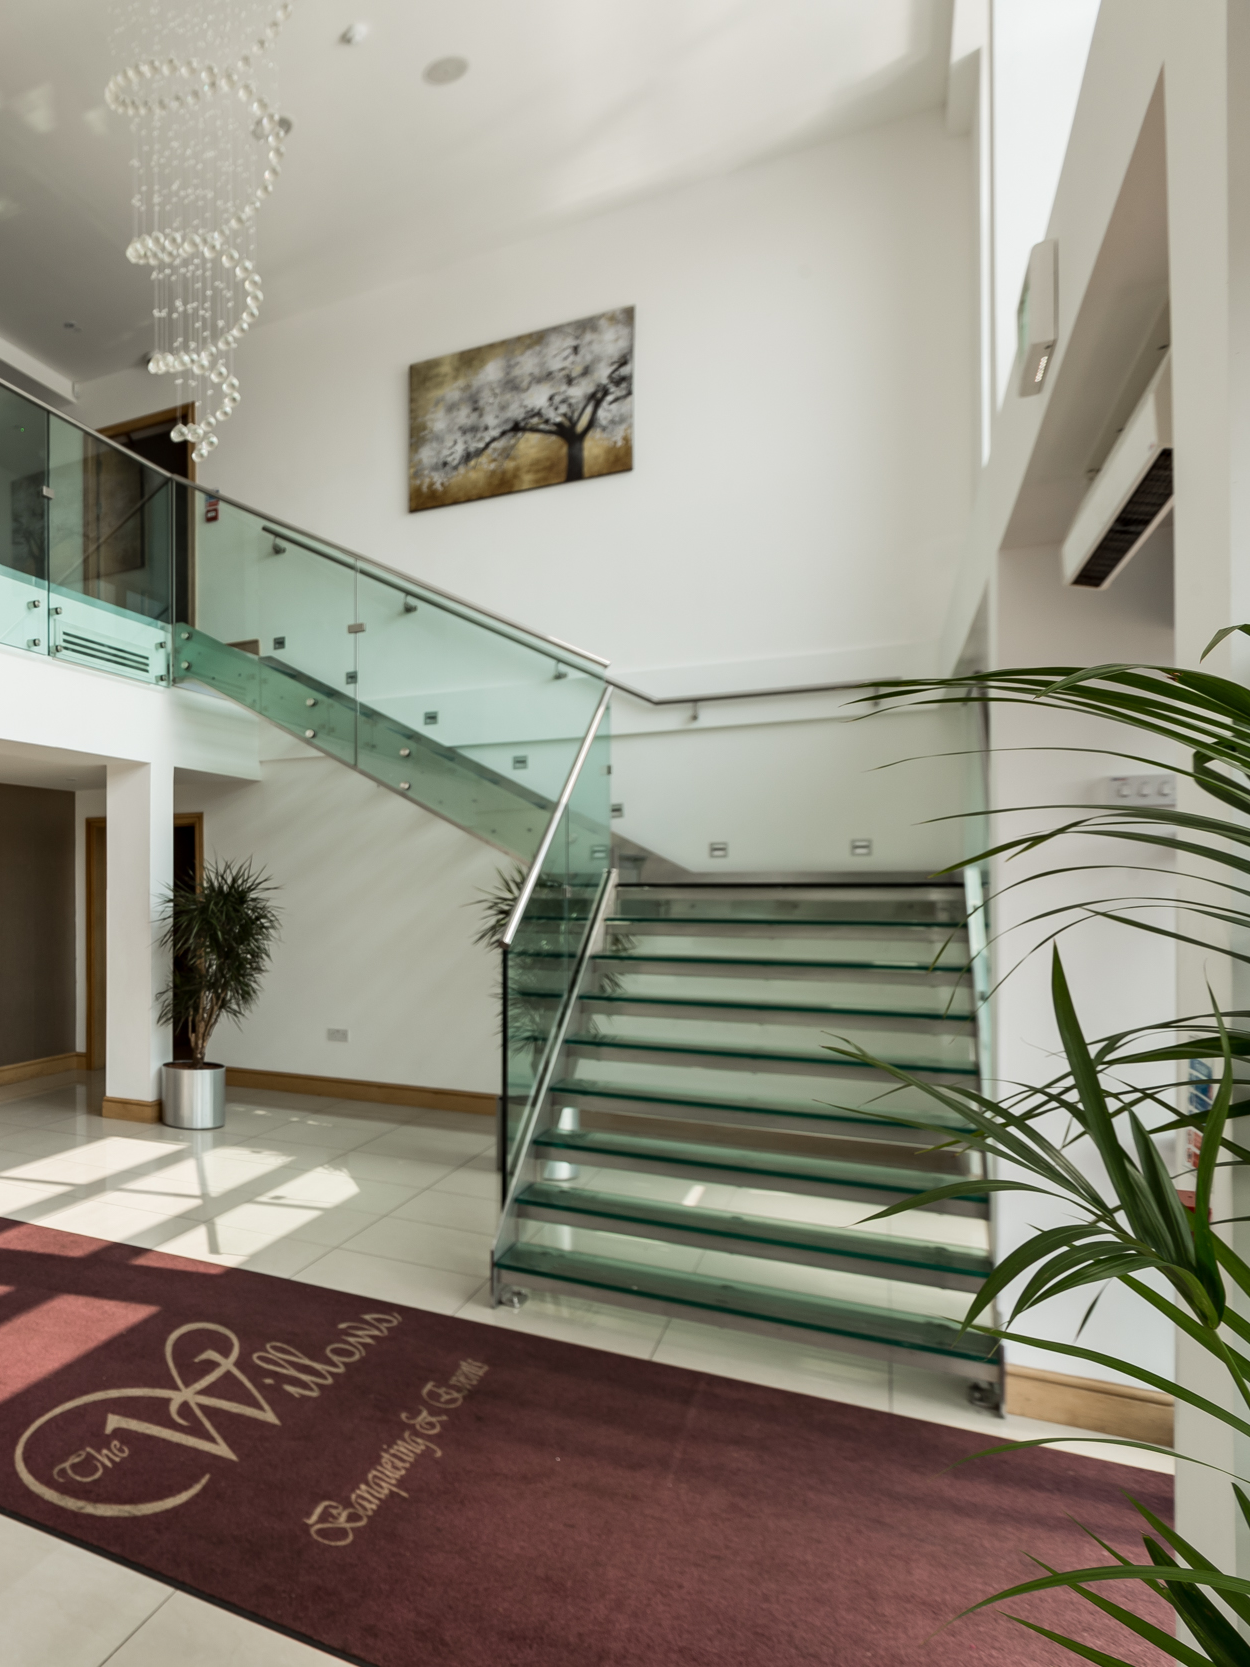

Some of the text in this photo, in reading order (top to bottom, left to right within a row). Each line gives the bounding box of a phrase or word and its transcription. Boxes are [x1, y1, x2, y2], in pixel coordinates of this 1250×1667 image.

[53, 1313, 402, 1483] The Willows
[303, 1358, 489, 1546] Banqueting & Events
